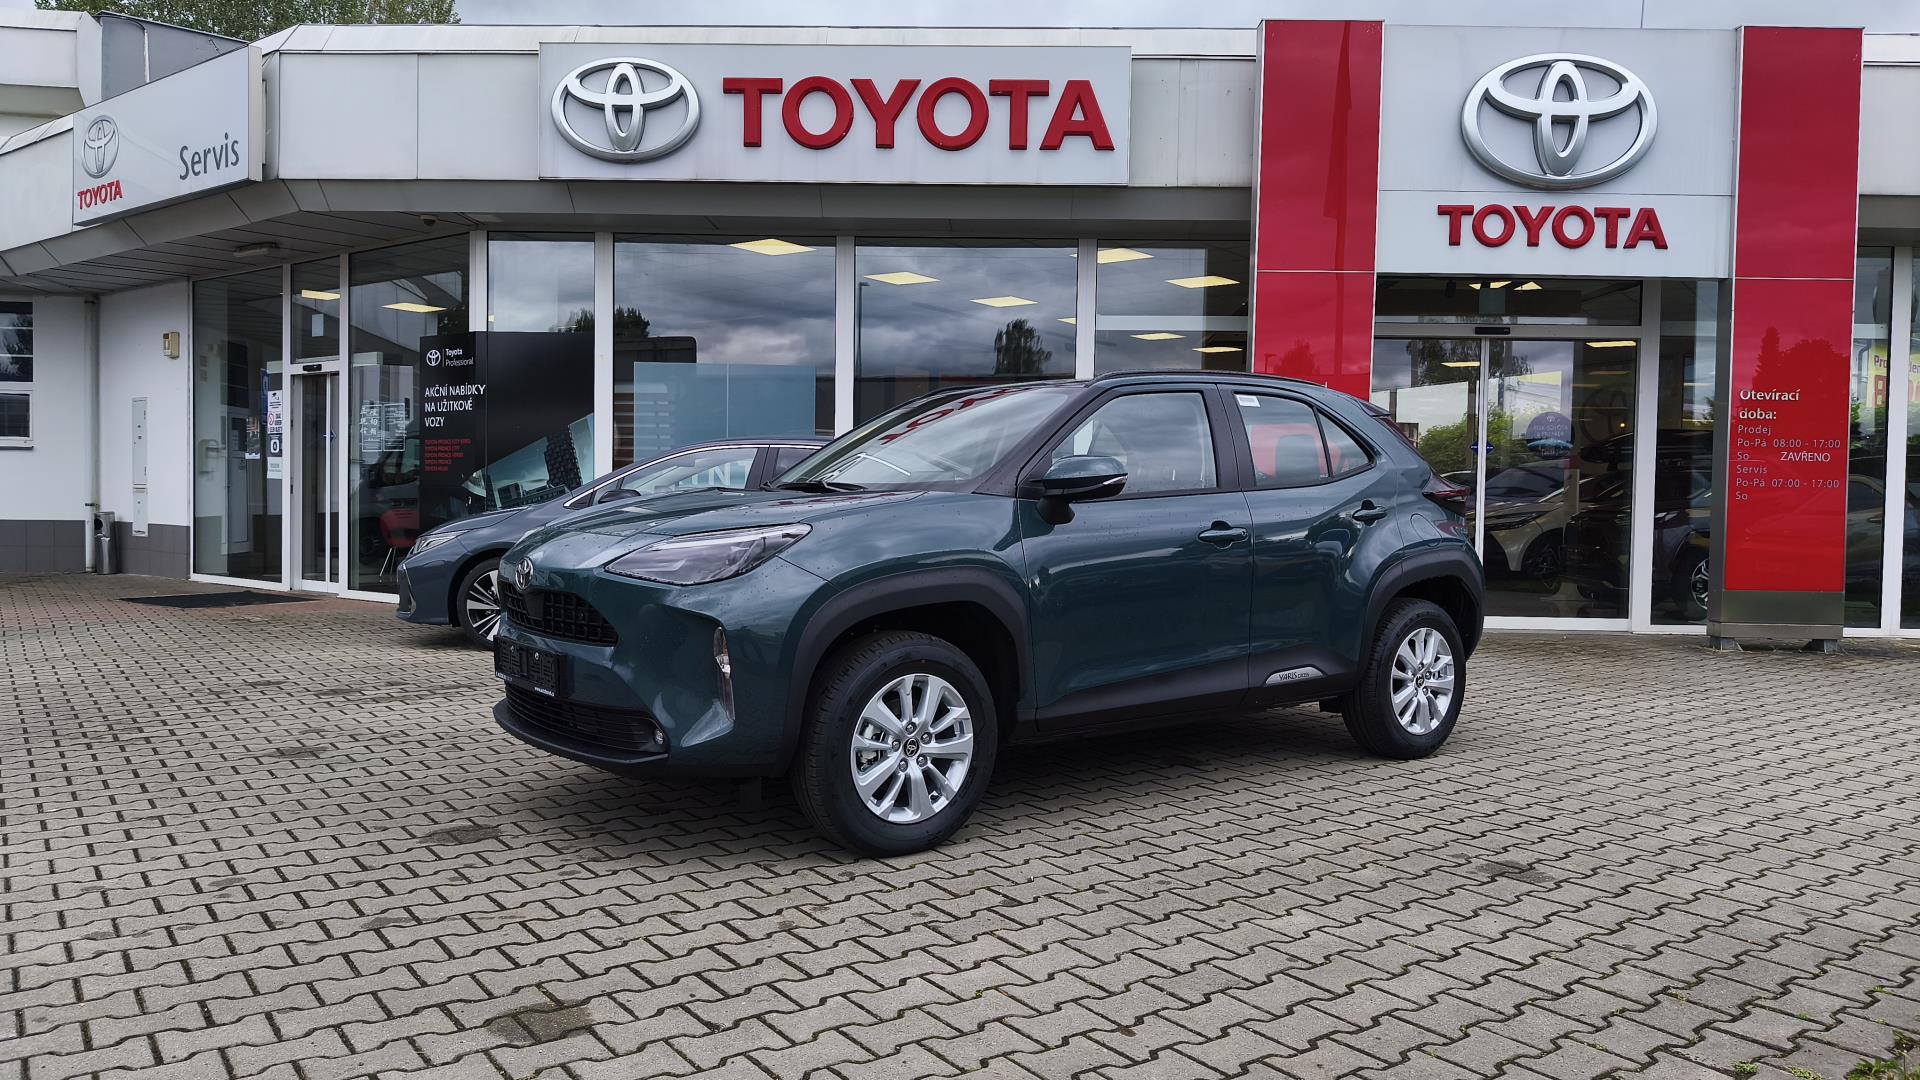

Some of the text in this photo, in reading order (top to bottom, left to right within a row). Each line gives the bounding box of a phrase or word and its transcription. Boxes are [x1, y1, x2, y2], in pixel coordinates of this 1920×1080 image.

[722, 75, 1115, 152] TOYOTA
[179, 132, 240, 181] Servis
[77, 180, 123, 209] TOYOTA
[1437, 203, 1669, 250] TOYOTA
[446, 349, 463, 357] Toyota
[425, 383, 486, 397] AKČNÍ NABÍDKY
[1739, 388, 1801, 401] Otevírací
[425, 398, 473, 412] NA UŽITKOVÉ
[1739, 407, 1777, 420] doba:
[425, 417, 444, 427] VOZY
[1738, 425, 1772, 436] Prodej
[1737, 438, 1767, 447] Po-Pá
[1773, 439, 1801, 448] 08:00
[1813, 440, 1840, 448] 17:00
[1737, 450, 1831, 462] So ZAVŘENO
[1736, 464, 1768, 474] Servis
[1736, 478, 1765, 487] Po-Pá
[1771, 479, 1800, 488] 07:00
[1812, 480, 1840, 488] 17:00
[1736, 492, 1748, 500] So
